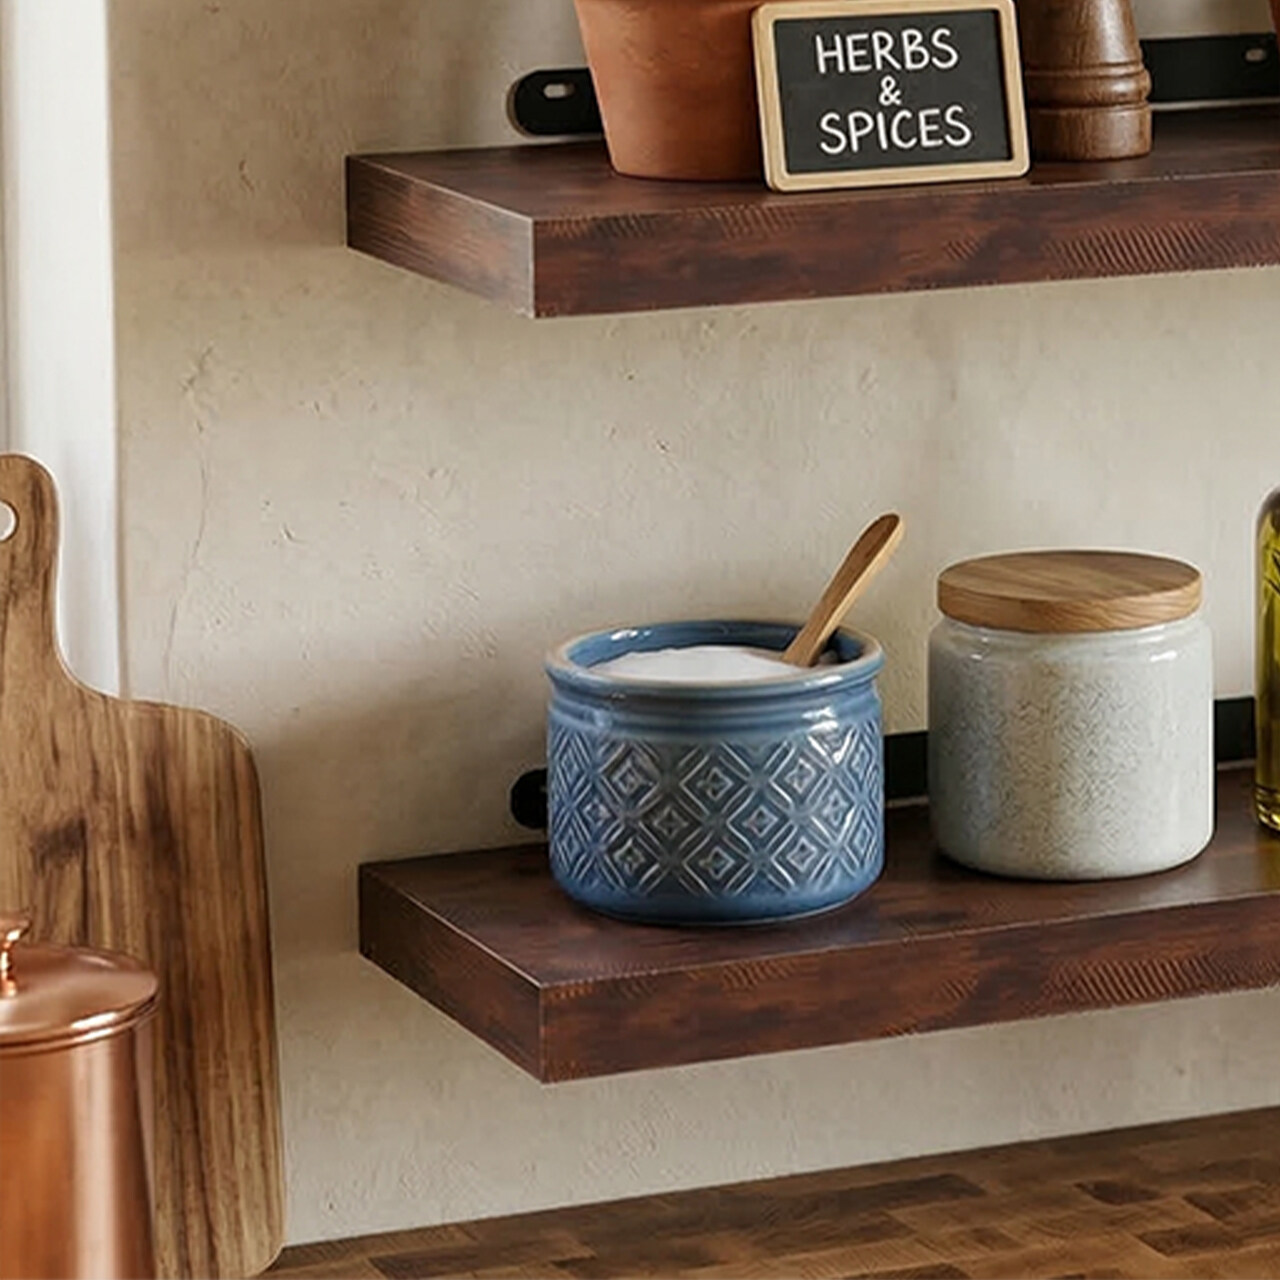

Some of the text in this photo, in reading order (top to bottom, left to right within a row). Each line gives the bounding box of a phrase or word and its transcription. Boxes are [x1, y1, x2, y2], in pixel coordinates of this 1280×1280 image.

[815, 27, 959, 74] HERBS
[878, 74, 902, 106] &
[819, 105, 973, 155] SPICES
